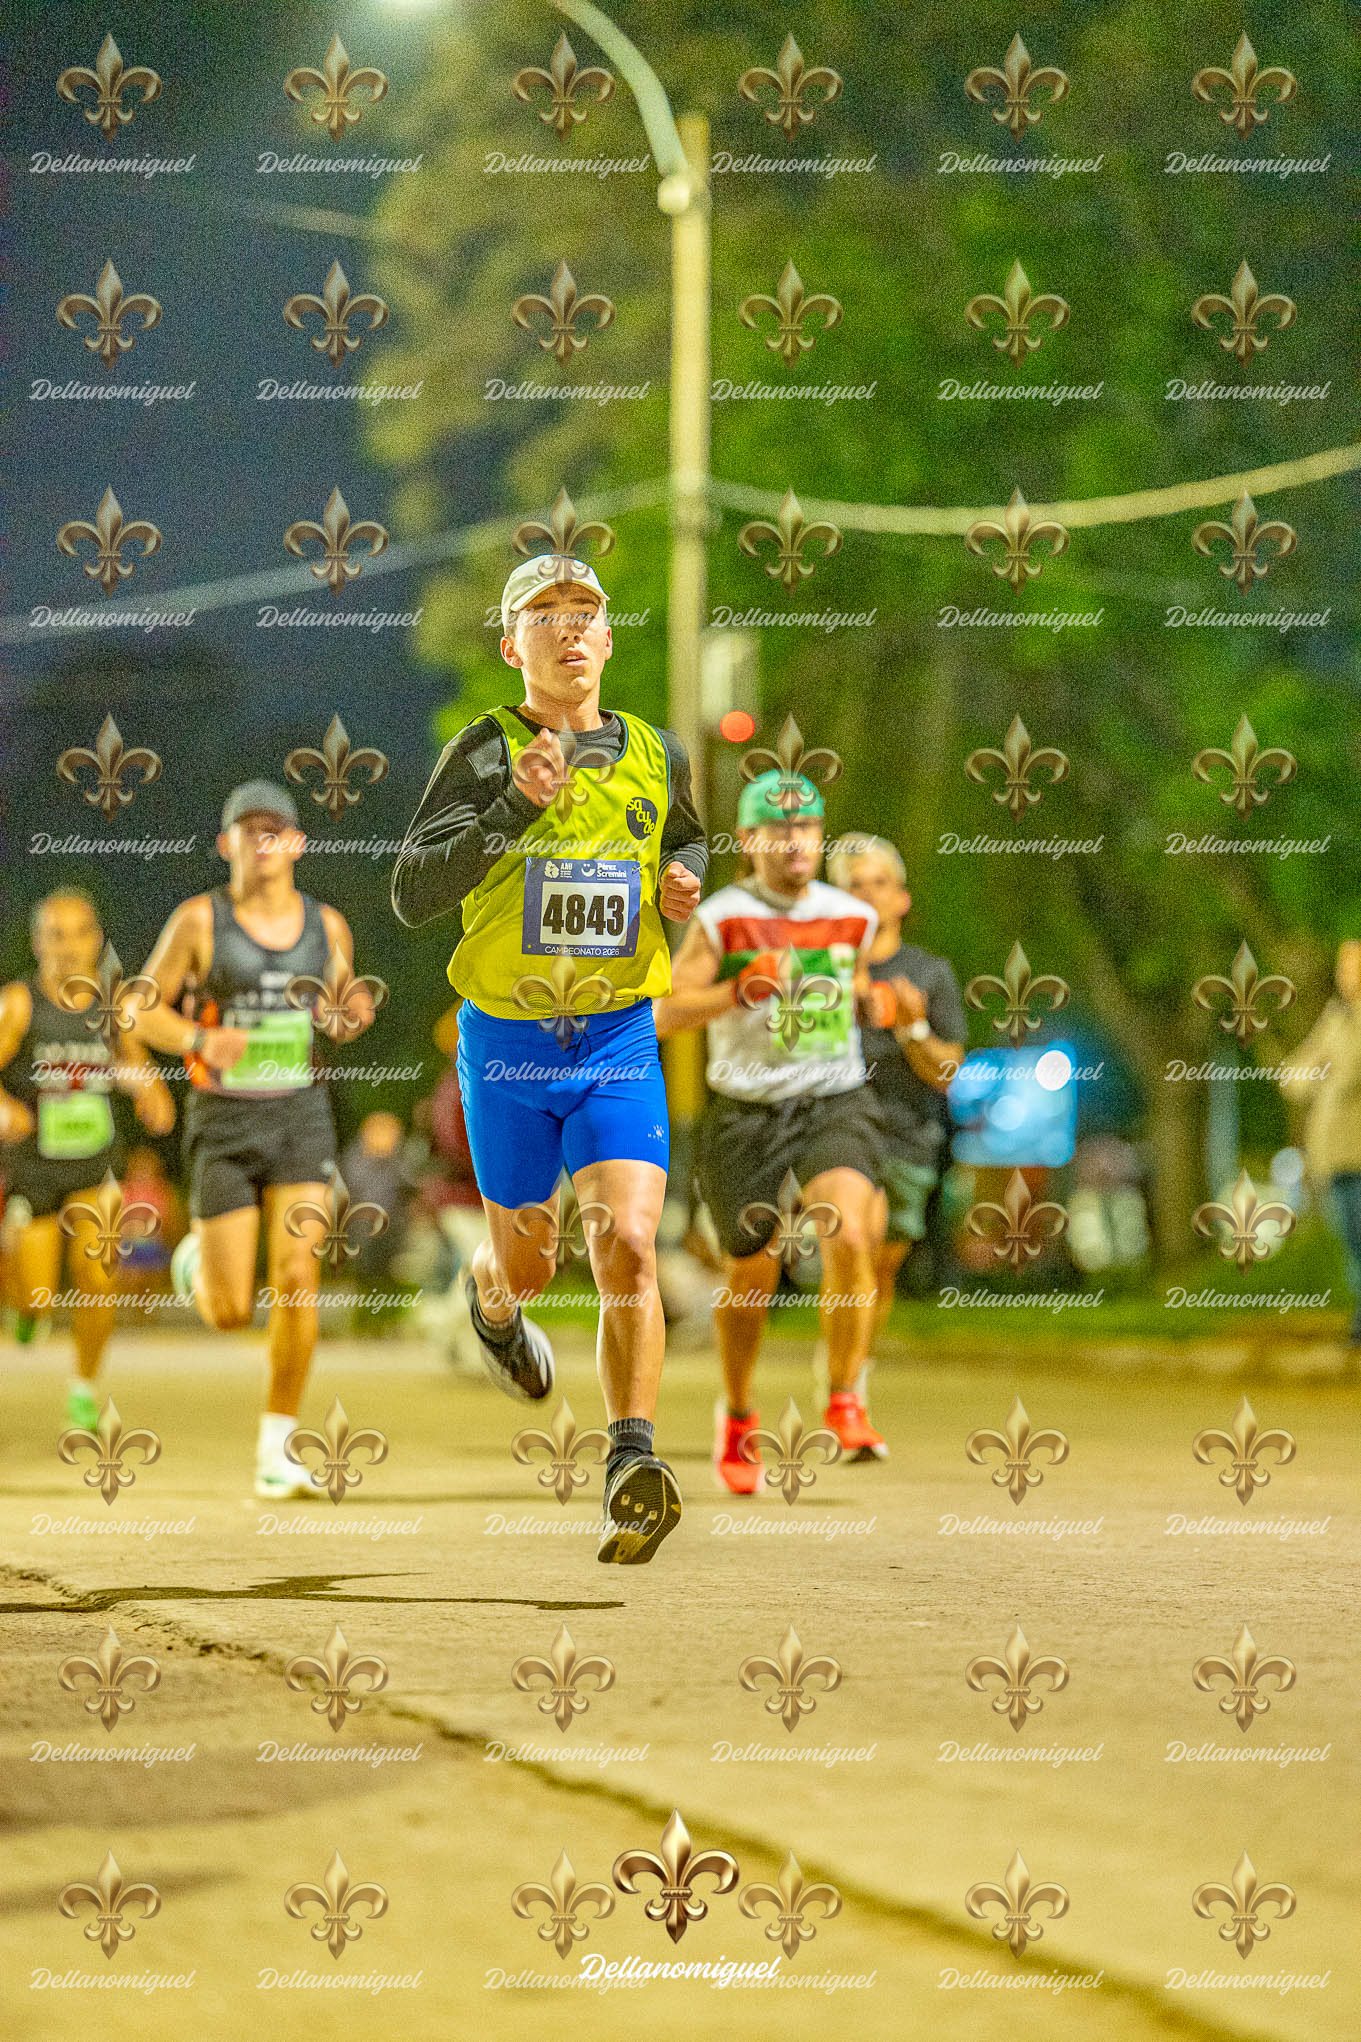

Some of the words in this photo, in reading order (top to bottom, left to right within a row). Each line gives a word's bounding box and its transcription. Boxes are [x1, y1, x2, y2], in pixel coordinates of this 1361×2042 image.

[597, 870, 628, 878] Scremini
[543, 894, 625, 937] 4843
[544, 946, 602, 956] CAMPEONATO
